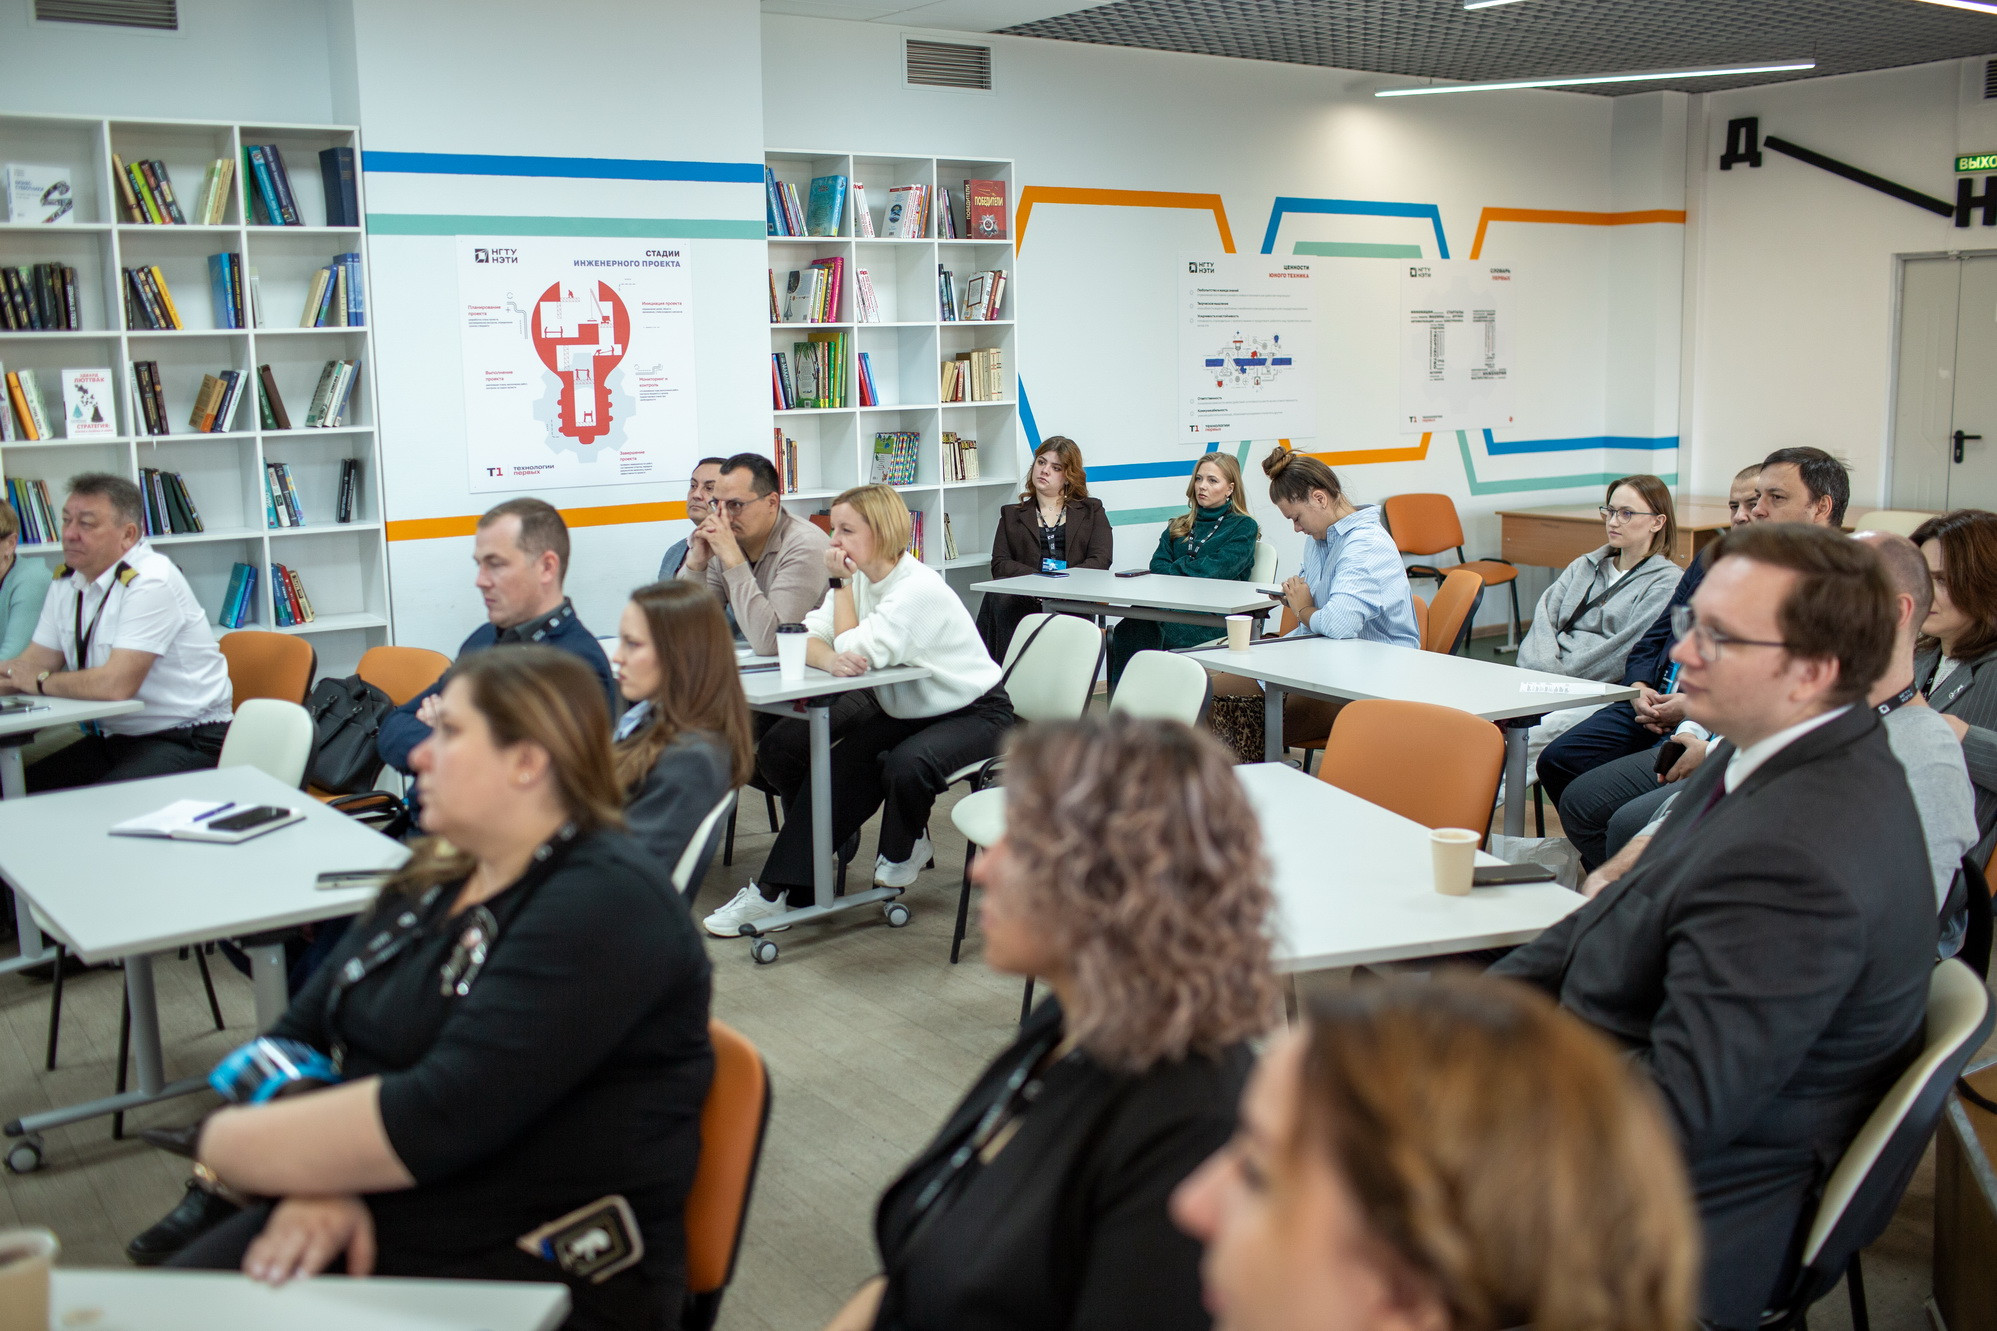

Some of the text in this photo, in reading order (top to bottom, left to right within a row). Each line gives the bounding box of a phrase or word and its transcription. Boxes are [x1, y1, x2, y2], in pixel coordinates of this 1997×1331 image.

[1720, 117, 1762, 171] Д
[974, 196, 1003, 207] ПОБЕДИТЕЛИ
[646, 250, 680, 258] СТАДИИ
